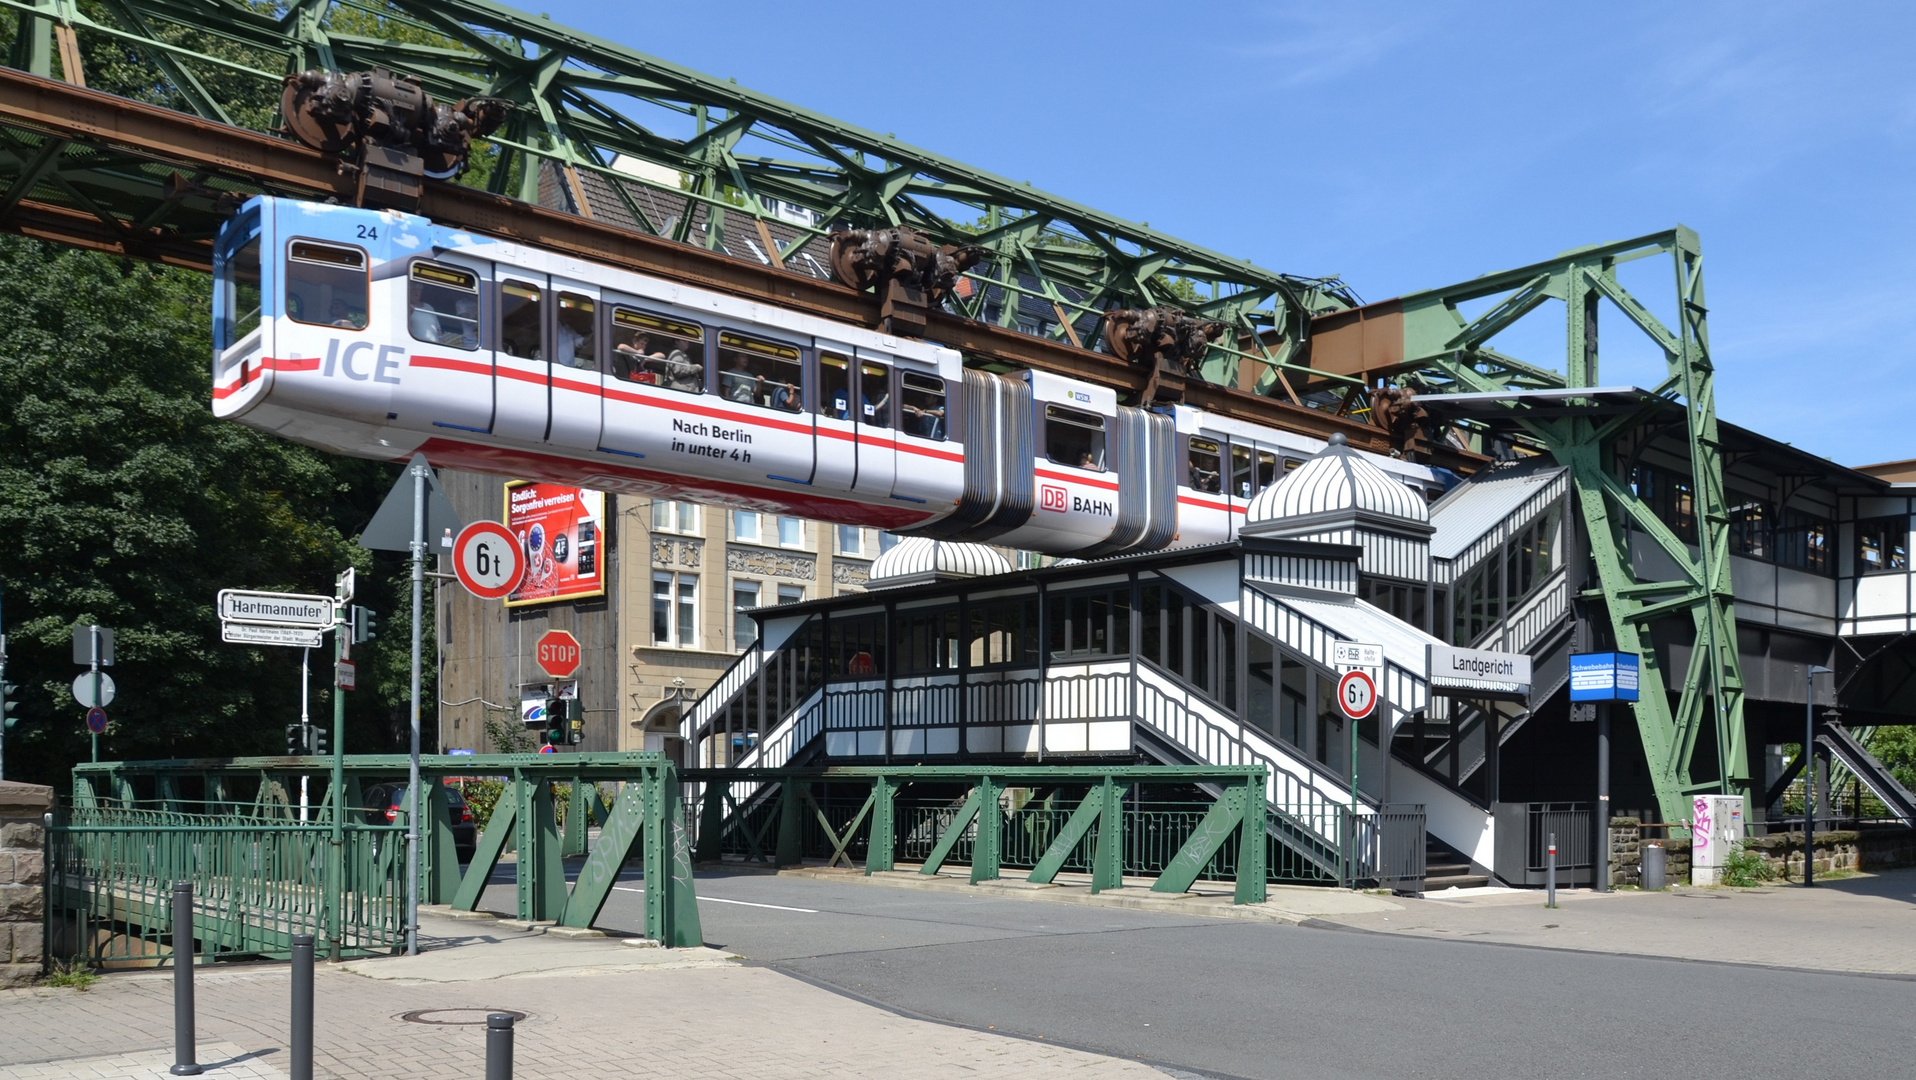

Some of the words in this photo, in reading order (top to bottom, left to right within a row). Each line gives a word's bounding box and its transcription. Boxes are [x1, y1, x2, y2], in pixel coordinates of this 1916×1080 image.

[357, 224, 378, 240] 24
[323, 338, 405, 385] ICE
[673, 418, 708, 436] Nach
[712, 425, 752, 444] Berlin
[671, 437, 685, 452] in
[688, 443, 727, 459] unter
[730, 448, 739, 461] 4
[742, 450, 751, 463] h
[511, 489, 537, 503] Endlich:
[511, 498, 544, 514] Sorgenfrei
[544, 493, 575, 507] verreisen
[1044, 488, 1065, 509] DB
[1073, 496, 1113, 517] BAHN
[477, 542, 489, 576] 6
[494, 554, 501, 577] t
[233, 600, 322, 618] Hartmannufer
[541, 644, 576, 663] STOP
[1452, 654, 1513, 676] Landgericht
[1571, 663, 1614, 671] Schwebebahn
[1348, 683, 1356, 704] 6
